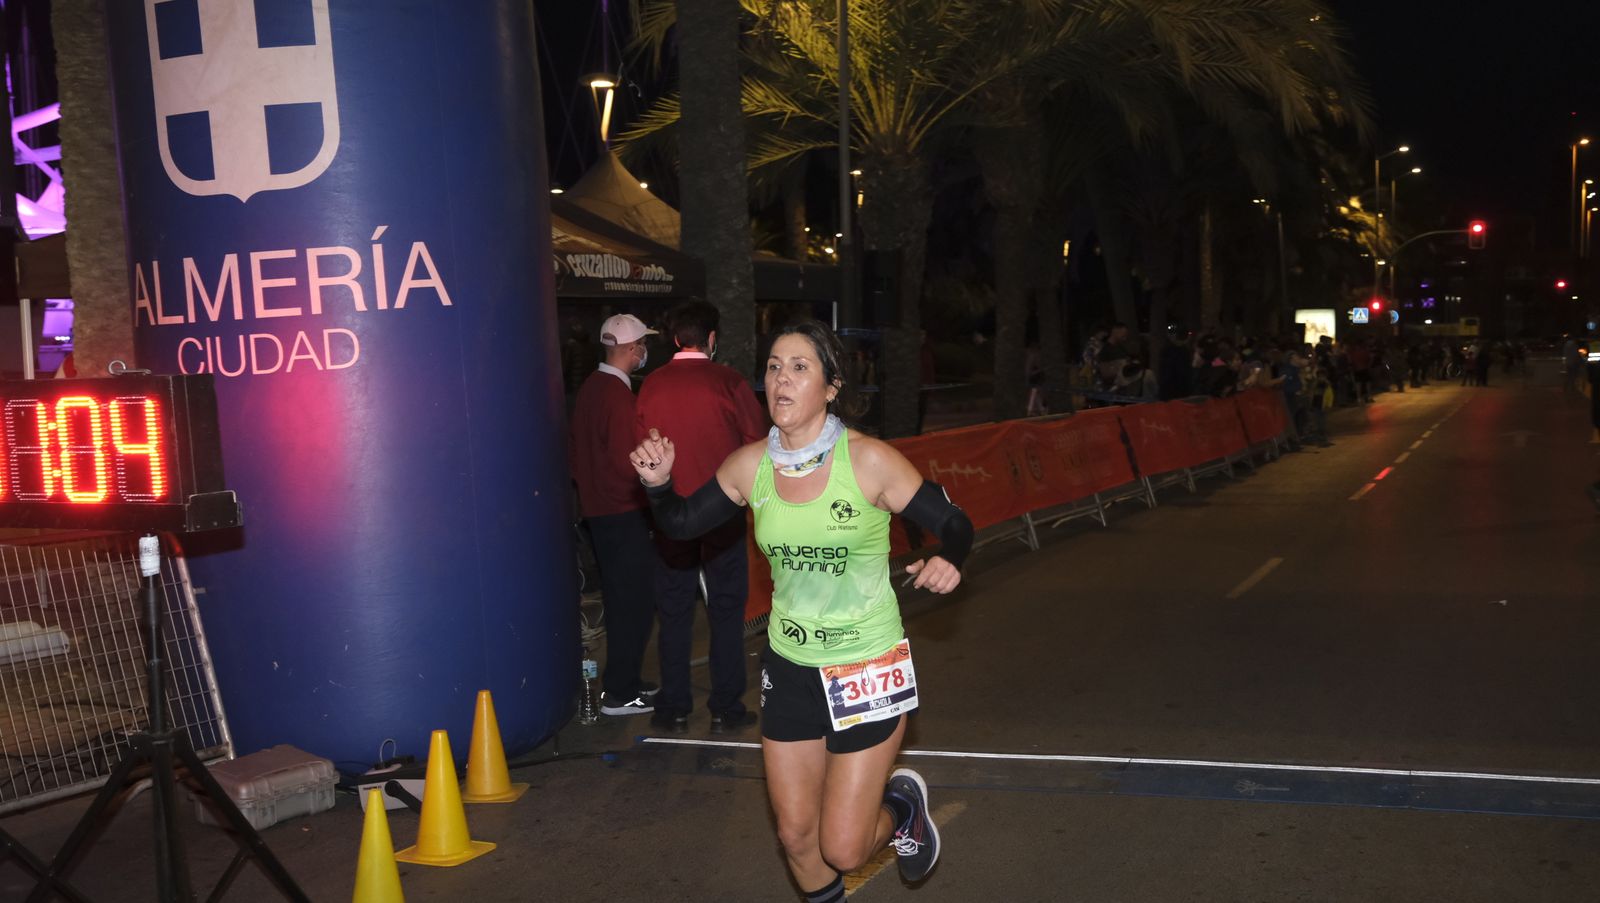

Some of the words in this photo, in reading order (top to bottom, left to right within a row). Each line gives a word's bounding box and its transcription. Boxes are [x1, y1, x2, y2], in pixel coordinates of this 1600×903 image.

[134, 225, 453, 327] ALMERÍA
[177, 328, 361, 377] CIUDAD
[0, 396, 166, 503] 1:04
[761, 543, 848, 560] Universo
[782, 558, 848, 577] Running
[844, 668, 905, 701] 3078
